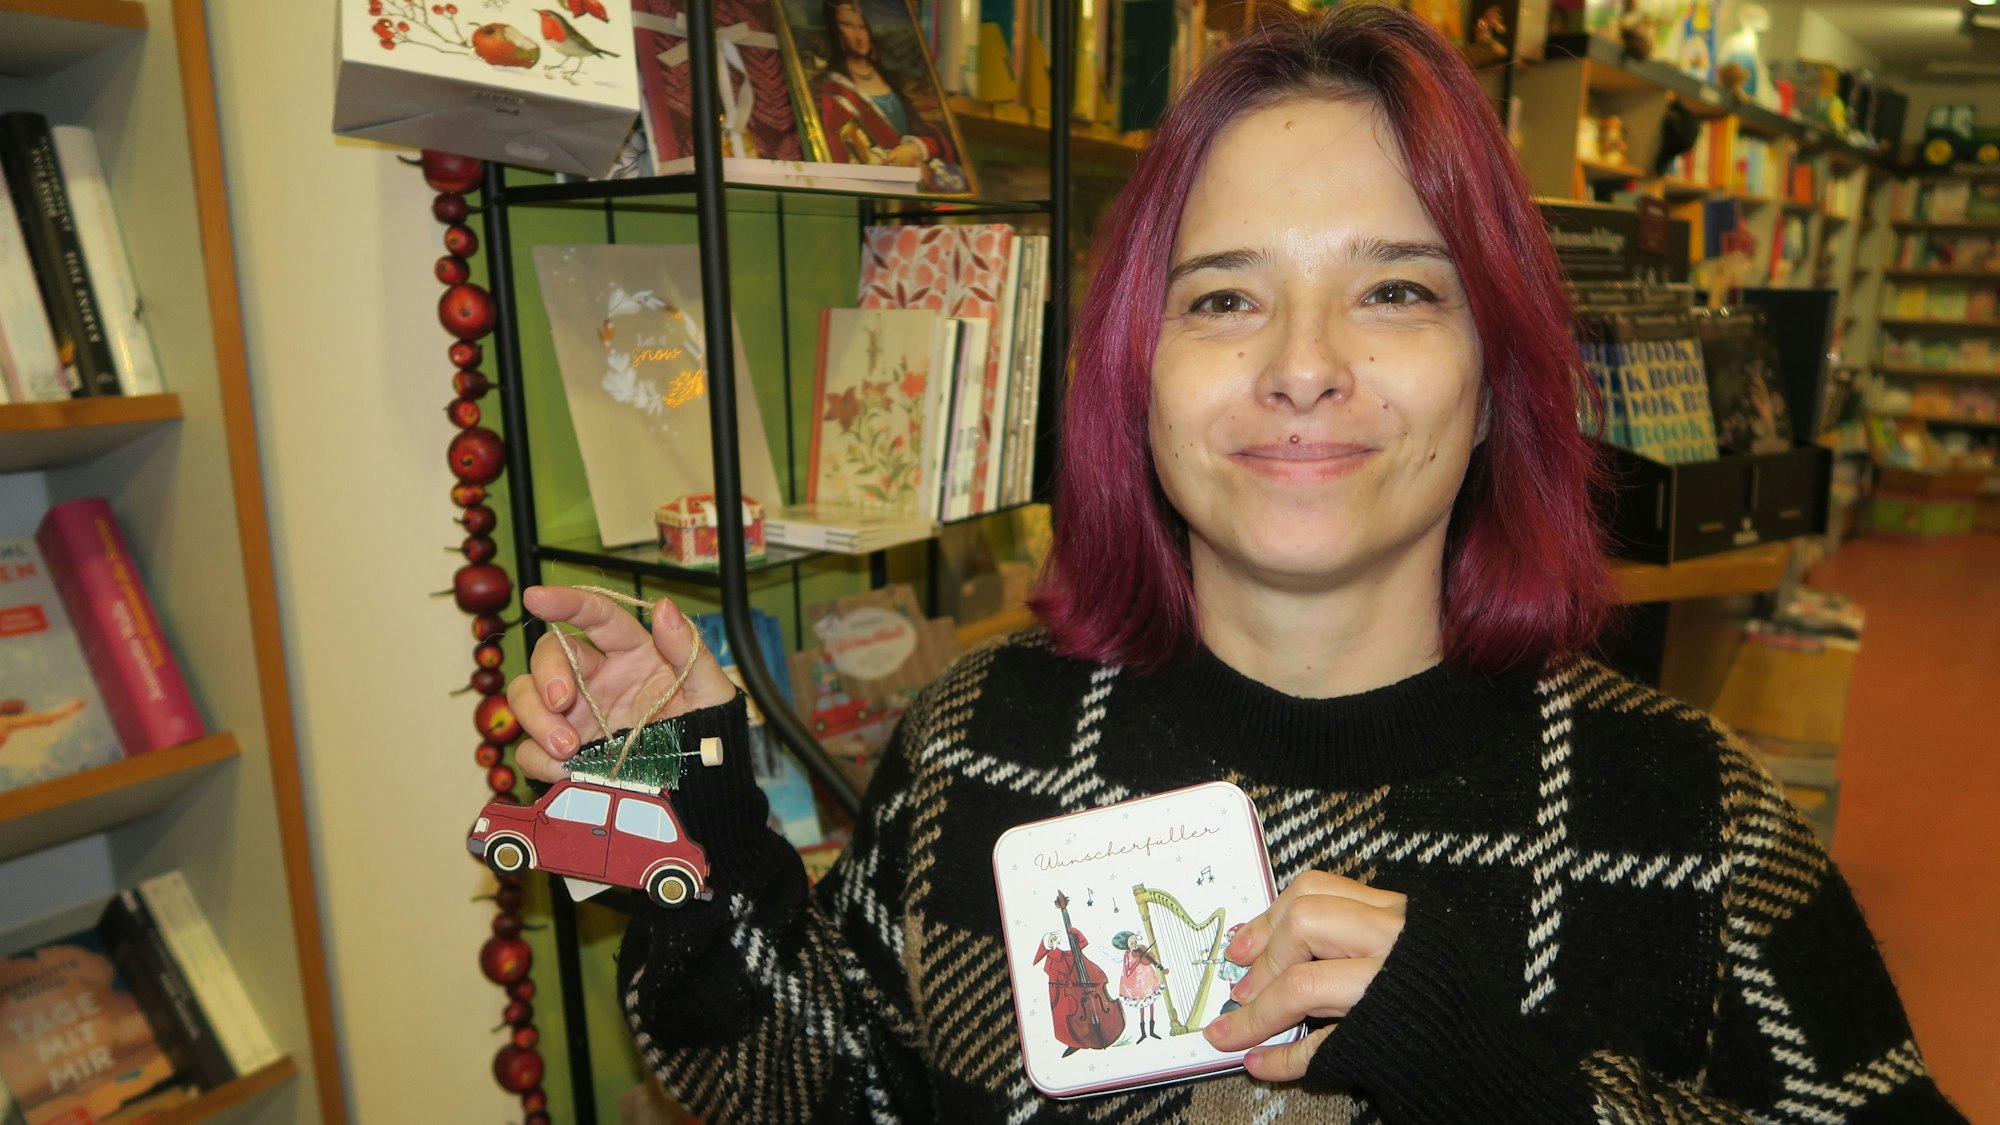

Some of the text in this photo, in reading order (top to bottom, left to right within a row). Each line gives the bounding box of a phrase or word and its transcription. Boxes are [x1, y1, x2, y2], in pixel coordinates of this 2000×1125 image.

[1034, 824, 1222, 871] Wunscherfüller
[7, 992, 102, 1044] TAGE
[36, 1020, 97, 1066] MIT
[48, 1046, 117, 1094] MIR
